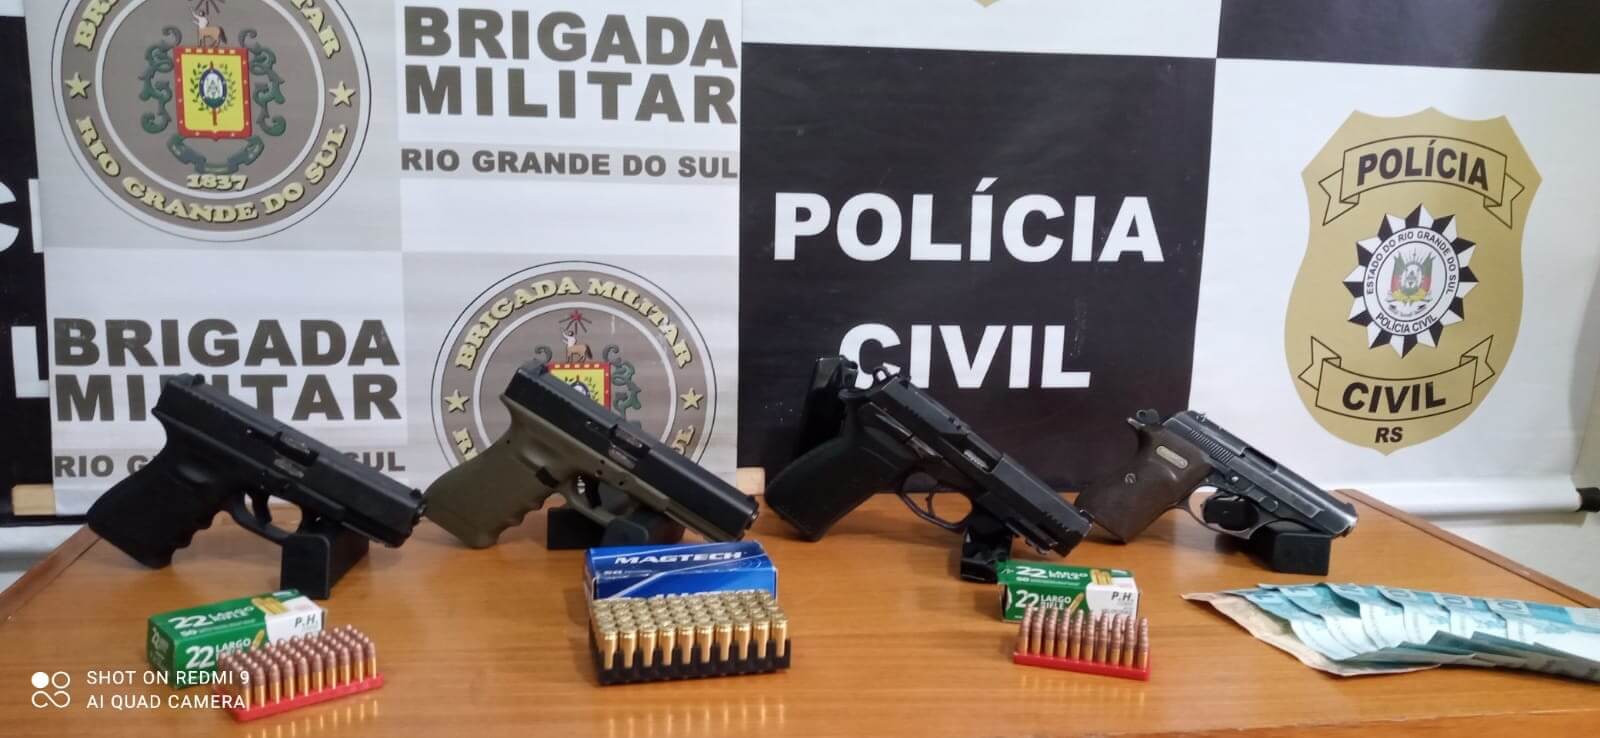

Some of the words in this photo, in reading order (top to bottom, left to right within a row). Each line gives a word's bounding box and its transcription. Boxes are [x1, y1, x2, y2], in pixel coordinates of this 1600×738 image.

[404, 6, 738, 69] BRIGADA
[404, 64, 737, 124] MILITAR
[76, 116, 122, 177] RIO
[122, 176, 259, 223] GRANDE
[264, 182, 306, 214] DO
[304, 124, 348, 184] SUL
[401, 148, 460, 172] RIO
[472, 150, 611, 176] GRANDE
[623, 154, 666, 178] DO
[678, 156, 738, 179] SUL
[1357, 139, 1489, 191] POLÍCIA
[185, 174, 248, 191] 1837
[774, 176, 1165, 263] POLÍCIA
[1382, 240, 1397, 253] DO
[1398, 231, 1414, 241] RIO
[1417, 230, 1450, 256] GRANDE
[1366, 252, 1384, 295] ESTADO
[1447, 256, 1457, 272] DO
[1445, 272, 1457, 295] SUL
[455, 277, 581, 371] BRIGADA
[588, 278, 693, 368] MILITAR
[1376, 312, 1411, 333] POLÍCIA
[1412, 314, 1437, 332] CIVIL
[54, 318, 400, 368] BRIGADA
[839, 323, 1091, 389] CIVIL
[55, 374, 402, 422] MITAR
[1342, 381, 1447, 414] CIVIL
[1374, 426, 1404, 444] RS
[54, 455, 114, 479] RIO
[614, 551, 742, 564] MAGTECH
[1016, 566, 1047, 579] 22
[1015, 589, 1039, 610] 22
[1041, 594, 1071, 604] LARGO
[168, 615, 213, 629] 22
[185, 645, 215, 669] 22
[216, 638, 251, 653] LARGO
